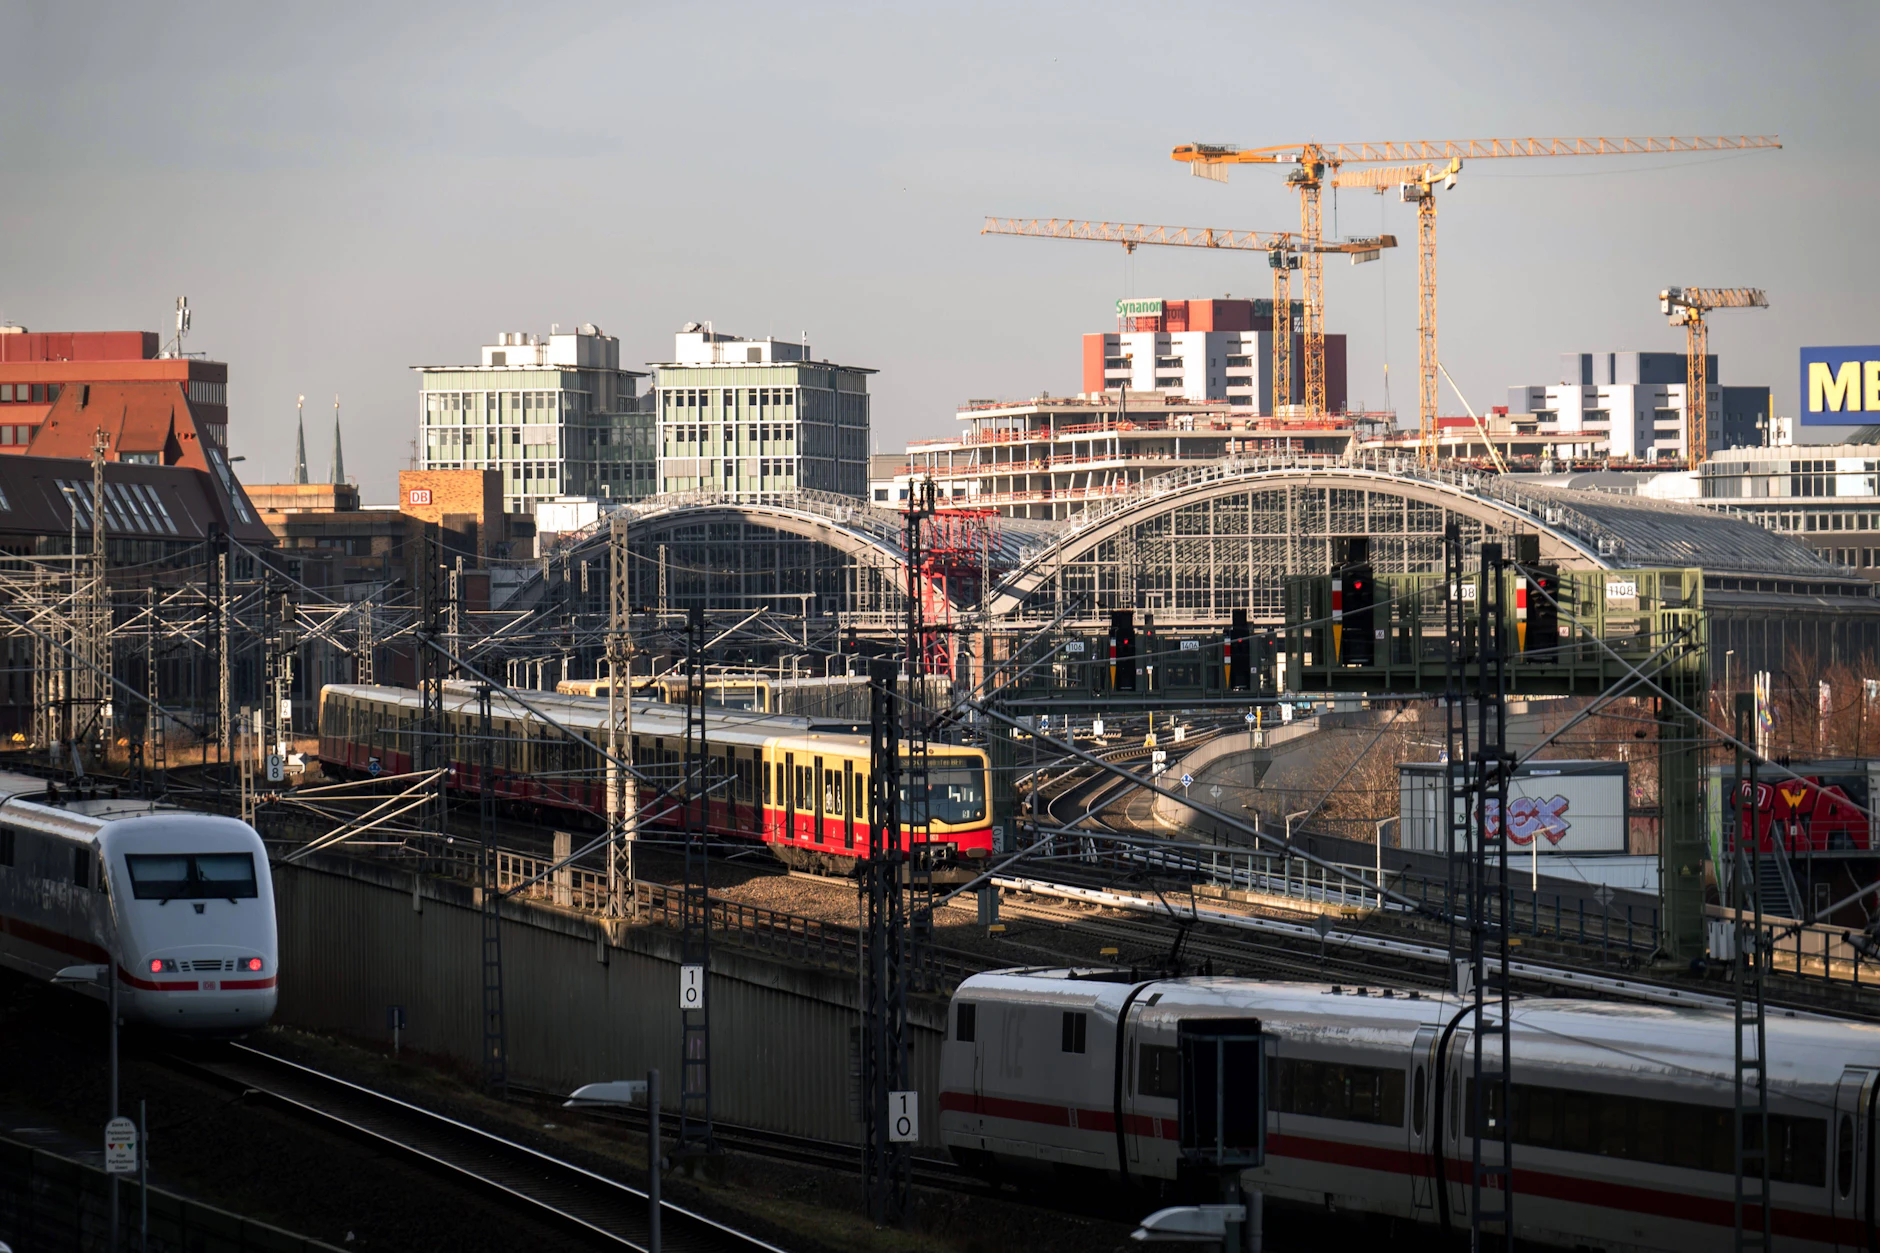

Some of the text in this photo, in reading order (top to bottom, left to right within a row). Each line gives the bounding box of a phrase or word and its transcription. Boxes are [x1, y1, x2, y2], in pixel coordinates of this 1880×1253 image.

[1116, 299, 1162, 317] Synanon
[411, 491, 429, 503] DB
[1610, 585, 1634, 596] 1108
[1068, 643, 1082, 651] 1106
[1182, 642, 1198, 650] 1406
[271, 756, 279, 766] 0
[271, 767, 279, 778] 8
[689, 970, 694, 985] 1
[204, 981, 215, 989] DB
[686, 987, 697, 1002] 0
[999, 1006, 1027, 1079] ICE
[900, 1095, 906, 1114] 1
[897, 1117, 910, 1136] 0
